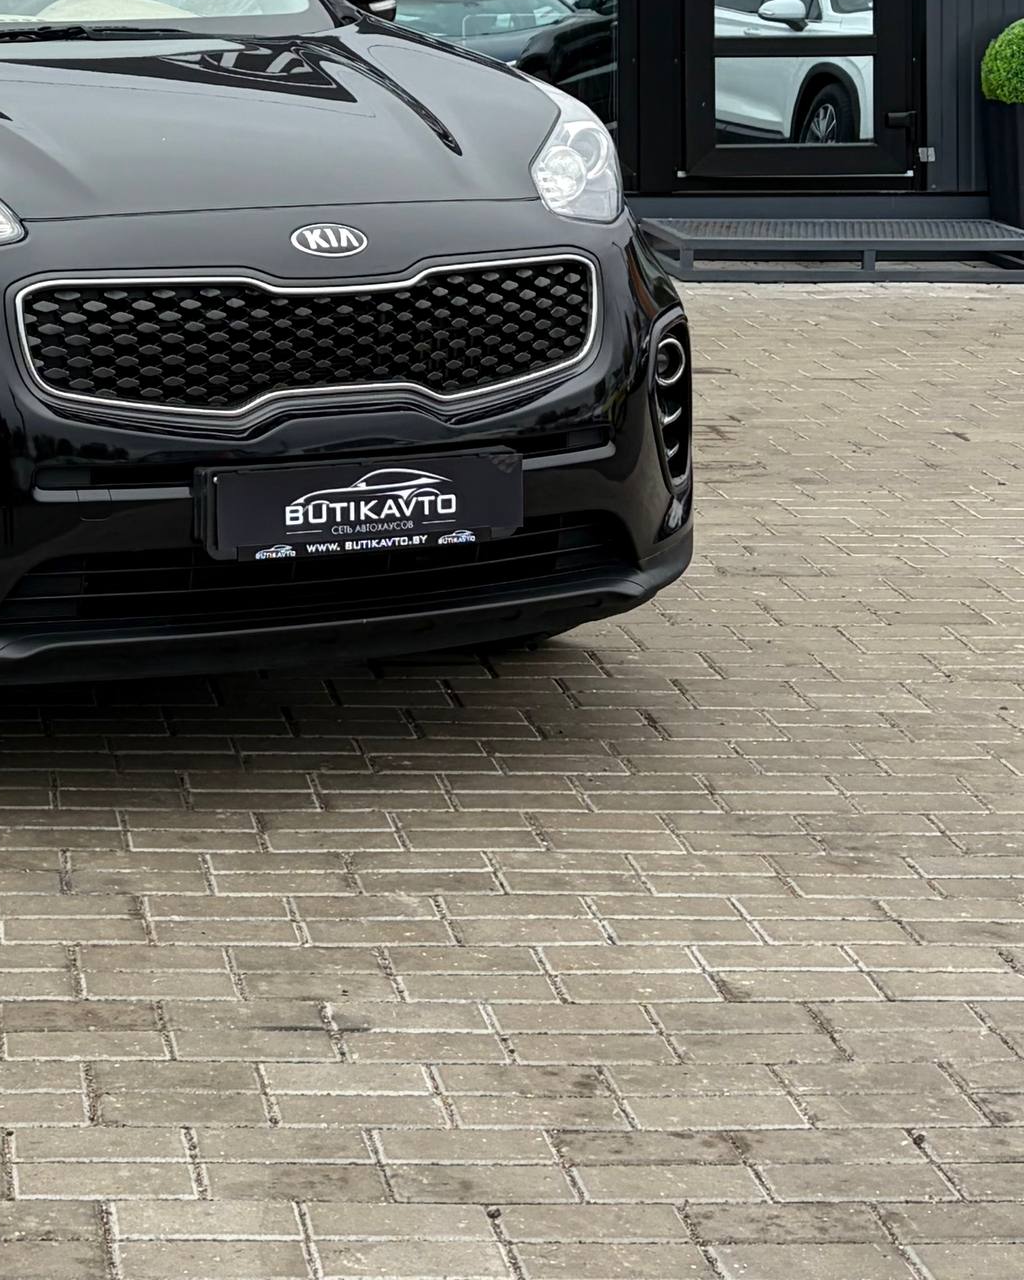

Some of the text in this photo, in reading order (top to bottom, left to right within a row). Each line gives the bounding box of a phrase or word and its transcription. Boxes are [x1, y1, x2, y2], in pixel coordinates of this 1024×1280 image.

[302, 228, 359, 249] KIA
[285, 493, 457, 526] BUTIKAVTO
[331, 520, 414, 535] СЕТЬ АВТОХАУСОВ
[345, 535, 428, 551] BUTIKAVTO.BY
